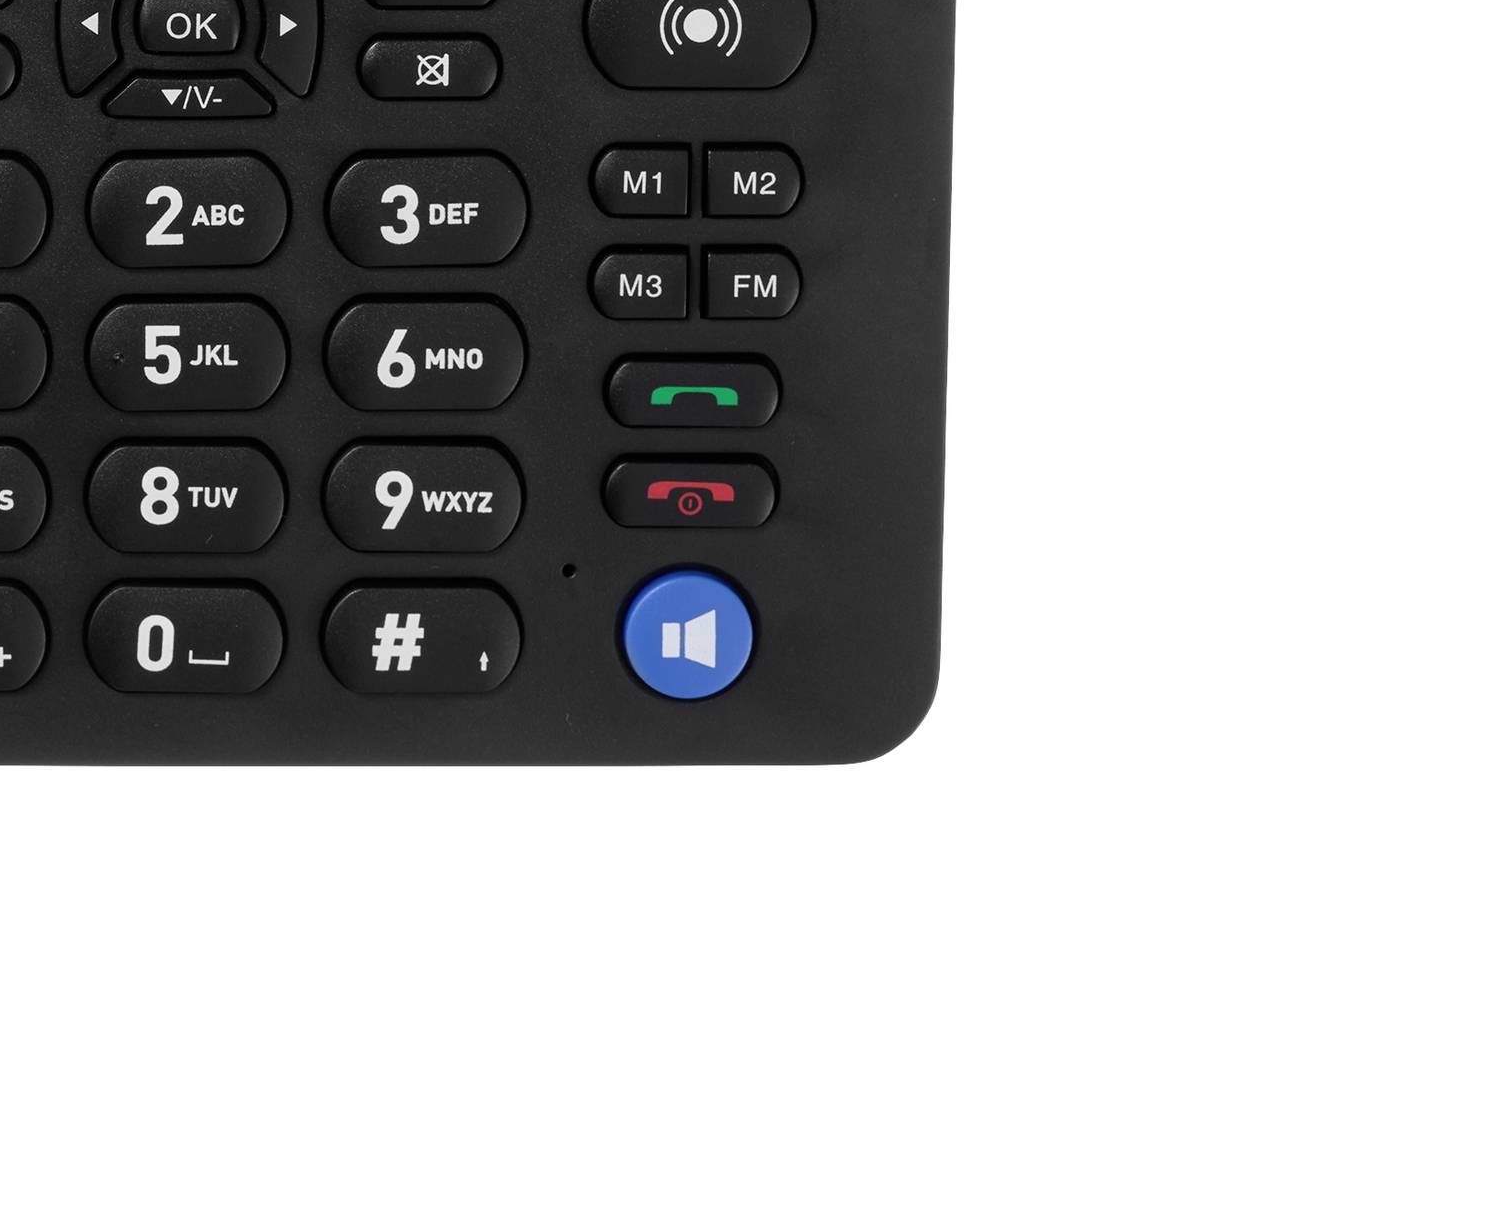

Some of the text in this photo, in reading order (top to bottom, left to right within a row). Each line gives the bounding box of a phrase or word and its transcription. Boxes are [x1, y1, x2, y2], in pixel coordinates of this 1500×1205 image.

[166, 12, 218, 40] OK
[623, 170, 662, 195] M1
[733, 171, 777, 196] M2
[145, 185, 245, 246] 2 ABC
[380, 184, 480, 245] 3 DEF
[619, 273, 663, 298] M3
[733, 274, 778, 298] FM
[143, 324, 239, 385] 5 JKL
[376, 328, 484, 389] 6 MNO
[139, 466, 239, 526] 8 TUV
[374, 470, 494, 530] 9 WXYZ
[136, 614, 175, 673] 0
